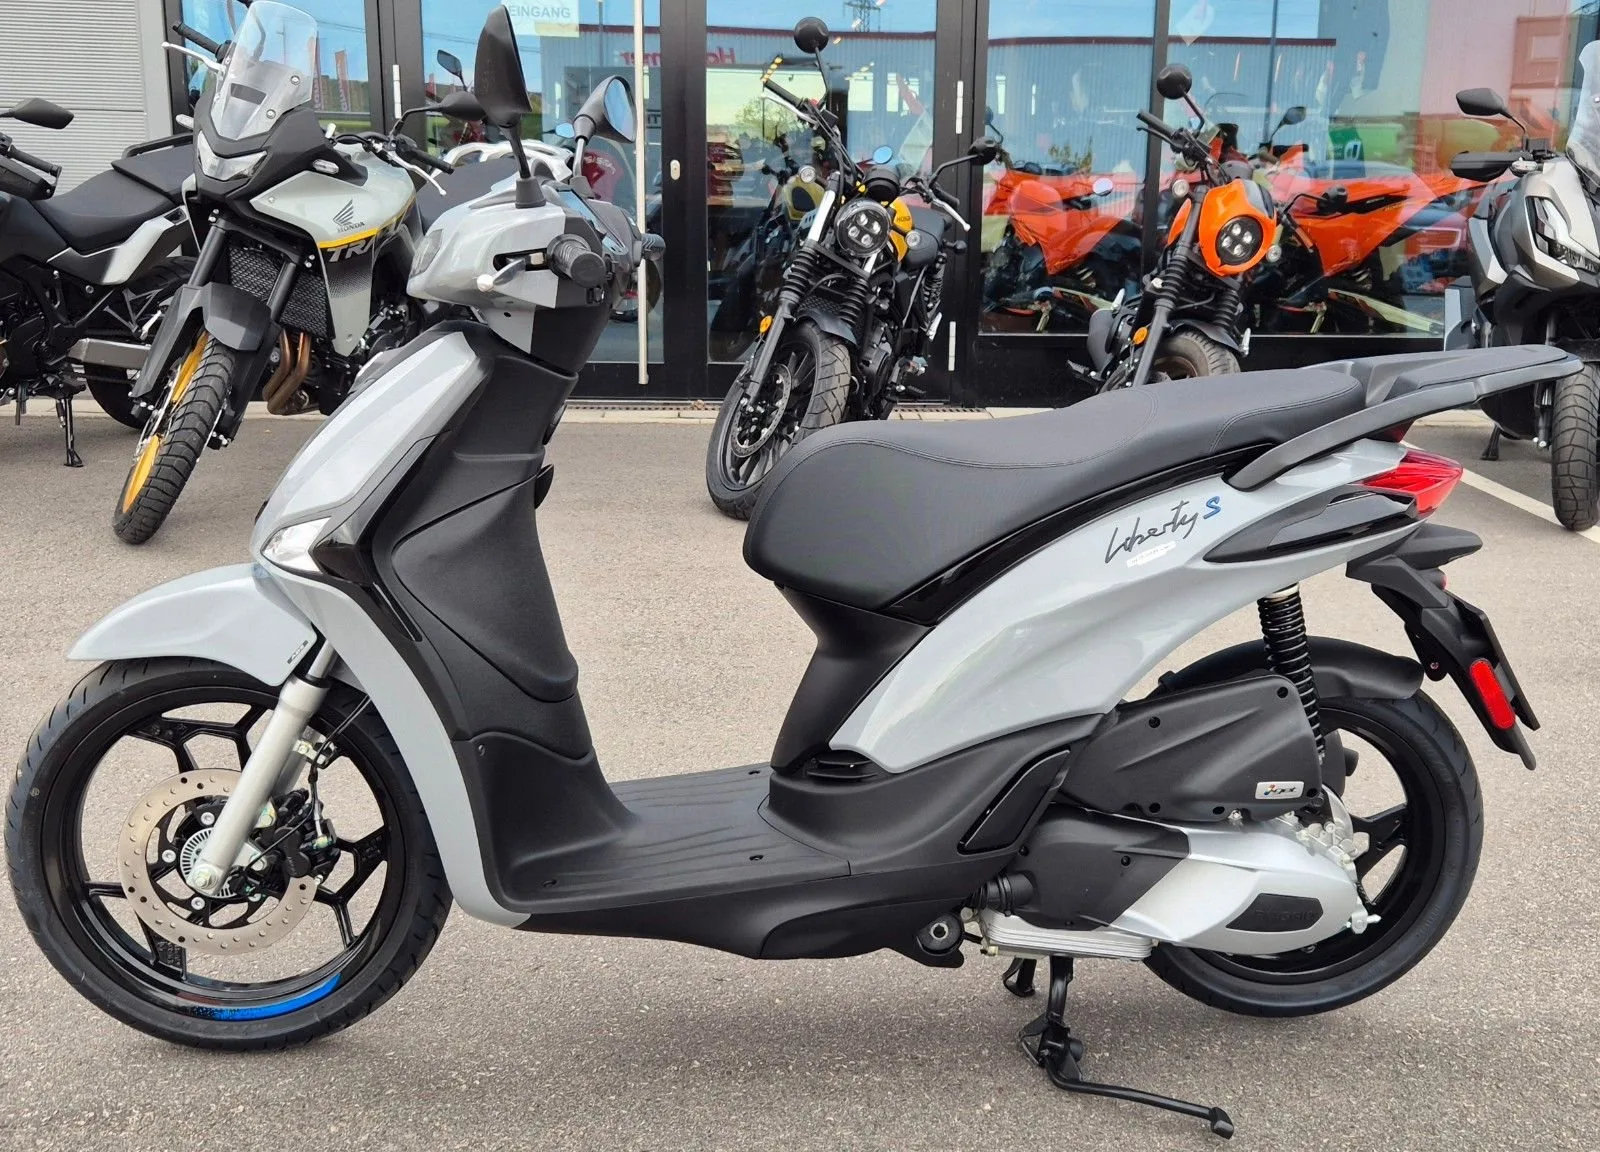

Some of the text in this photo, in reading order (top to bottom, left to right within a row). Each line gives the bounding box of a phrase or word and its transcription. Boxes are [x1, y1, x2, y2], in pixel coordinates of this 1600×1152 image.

[509, 6, 571, 18] EINGANG
[337, 221, 365, 233] HONDA
[1105, 500, 1198, 563] Liberty
[1203, 496, 1221, 519] S
